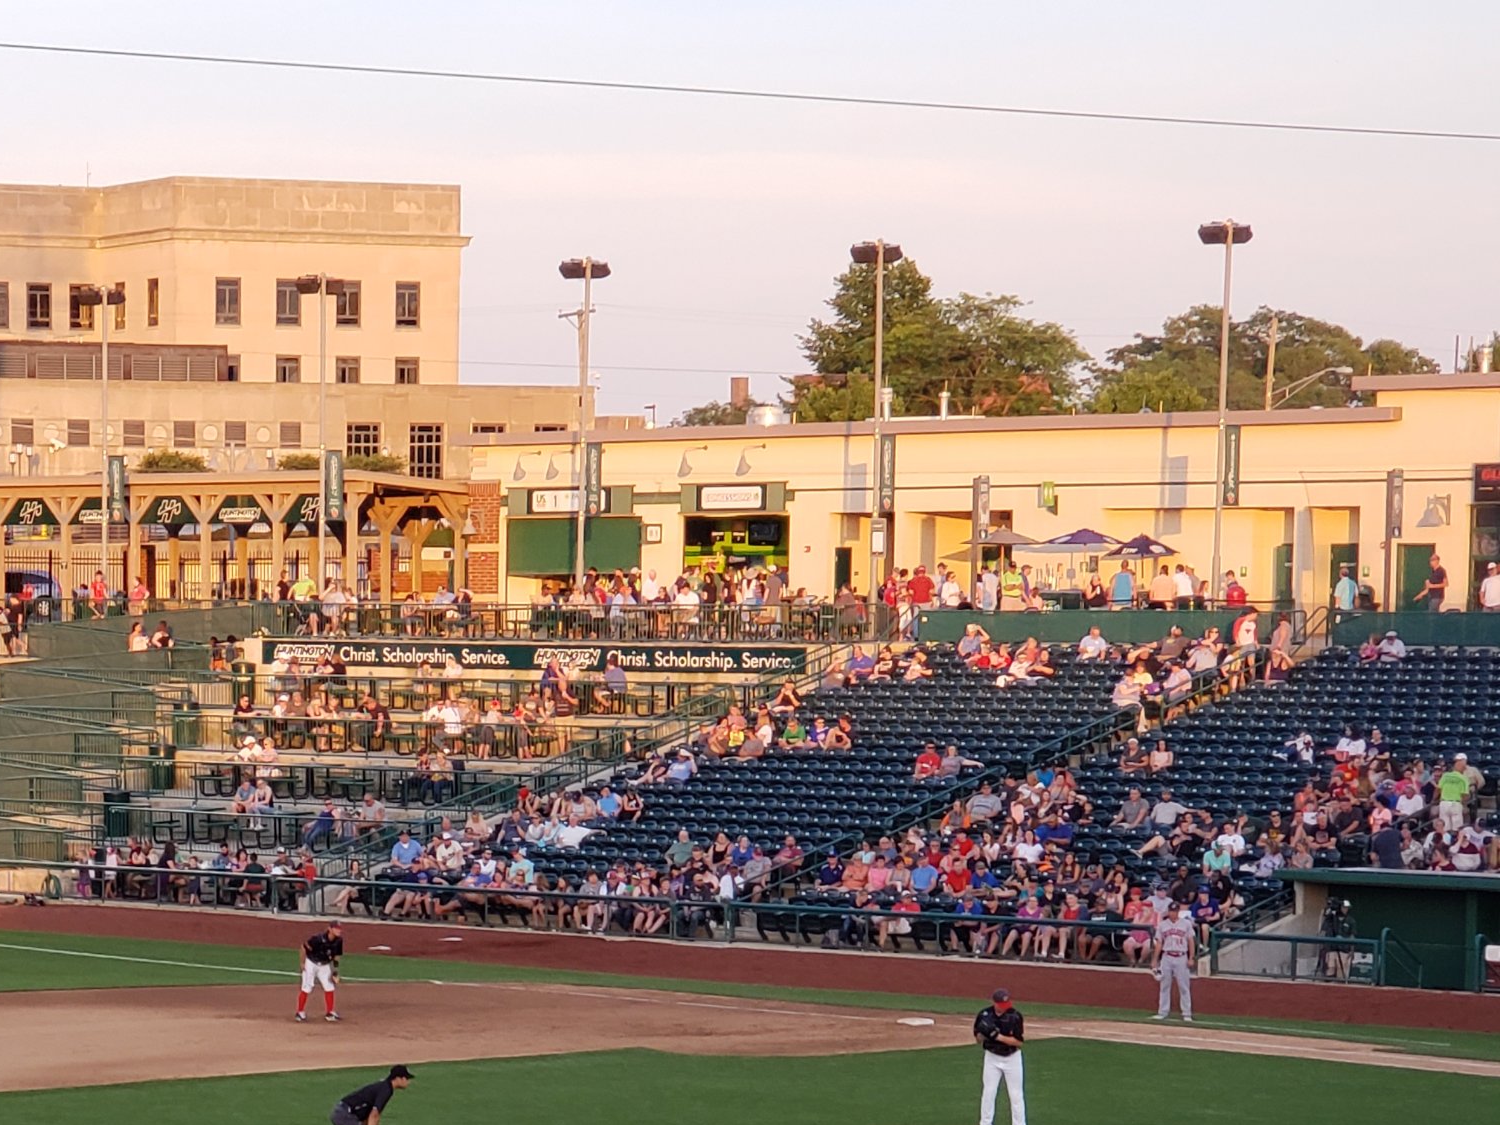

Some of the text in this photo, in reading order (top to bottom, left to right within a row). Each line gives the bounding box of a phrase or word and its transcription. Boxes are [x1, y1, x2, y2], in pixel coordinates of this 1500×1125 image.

[340, 646, 379, 662] Christ.
[461, 648, 510, 665] Service.
[654, 650, 737, 672] Scholarship.
